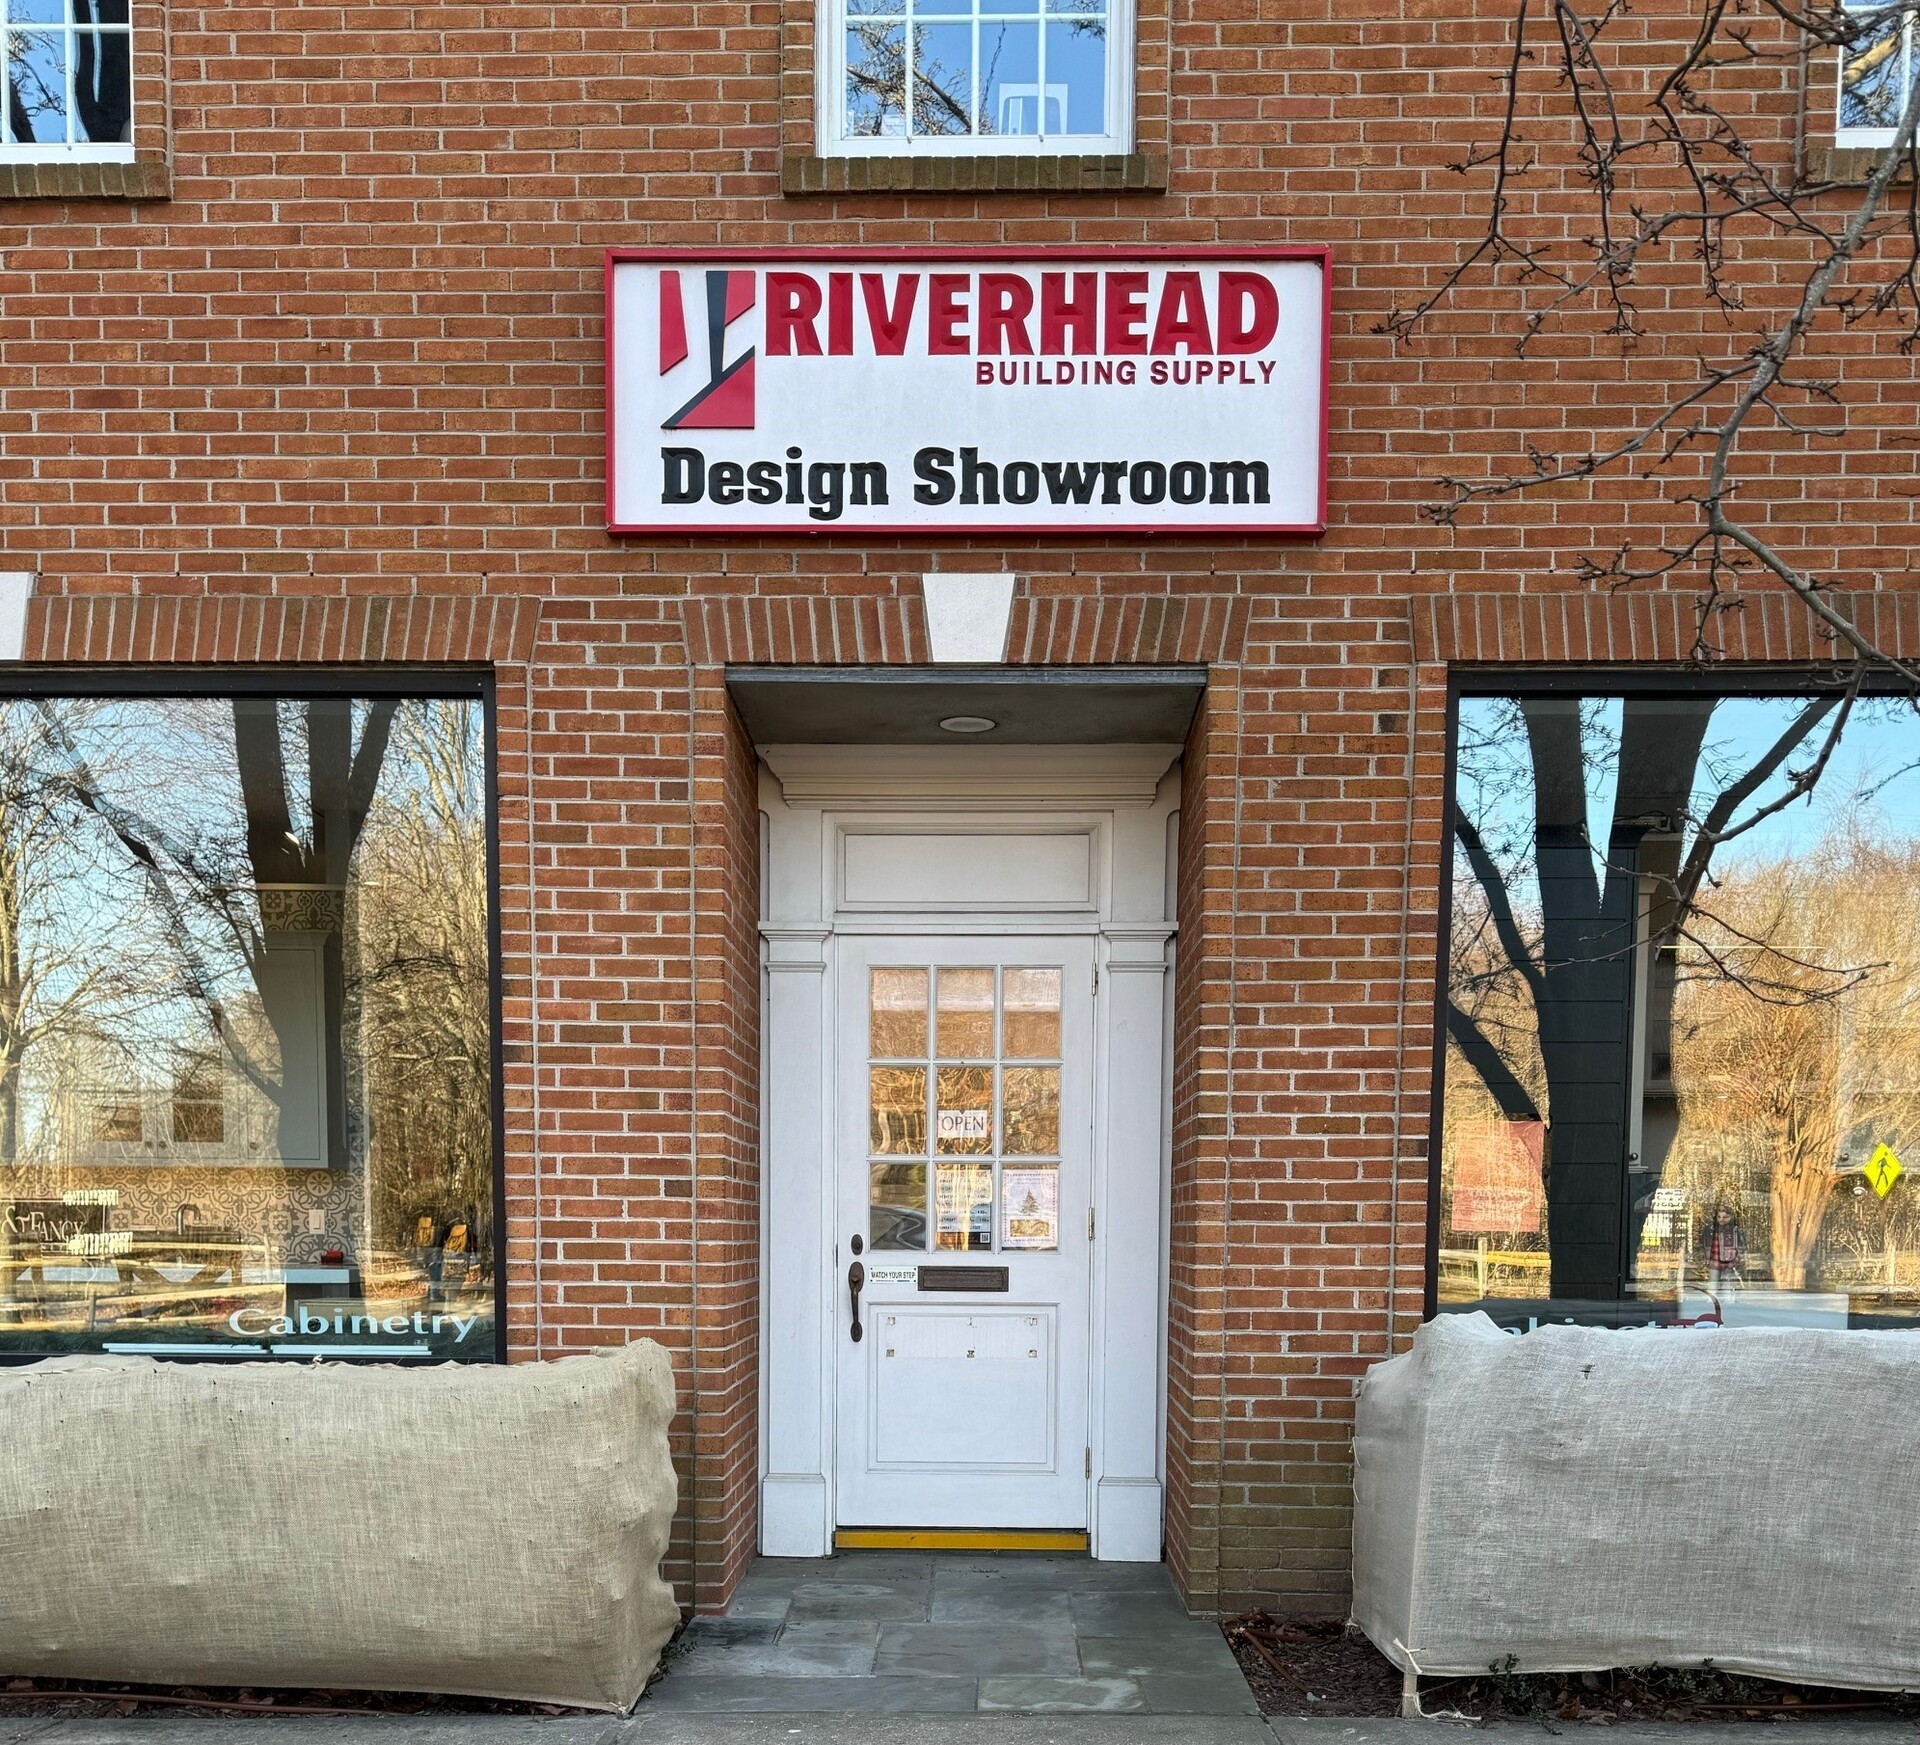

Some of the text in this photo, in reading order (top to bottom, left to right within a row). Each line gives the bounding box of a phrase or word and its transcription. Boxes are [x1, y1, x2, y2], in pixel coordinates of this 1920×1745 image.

[765, 270, 1279, 356] RIVERHEAD
[976, 360, 1277, 385] BUILDING SUPPLY
[661, 446, 1271, 521] Design Showroom
[941, 1115, 984, 1131] OPEN
[871, 1271, 916, 1279] WATCH YOUR STEP
[228, 1306, 478, 1342] Cabinetry
